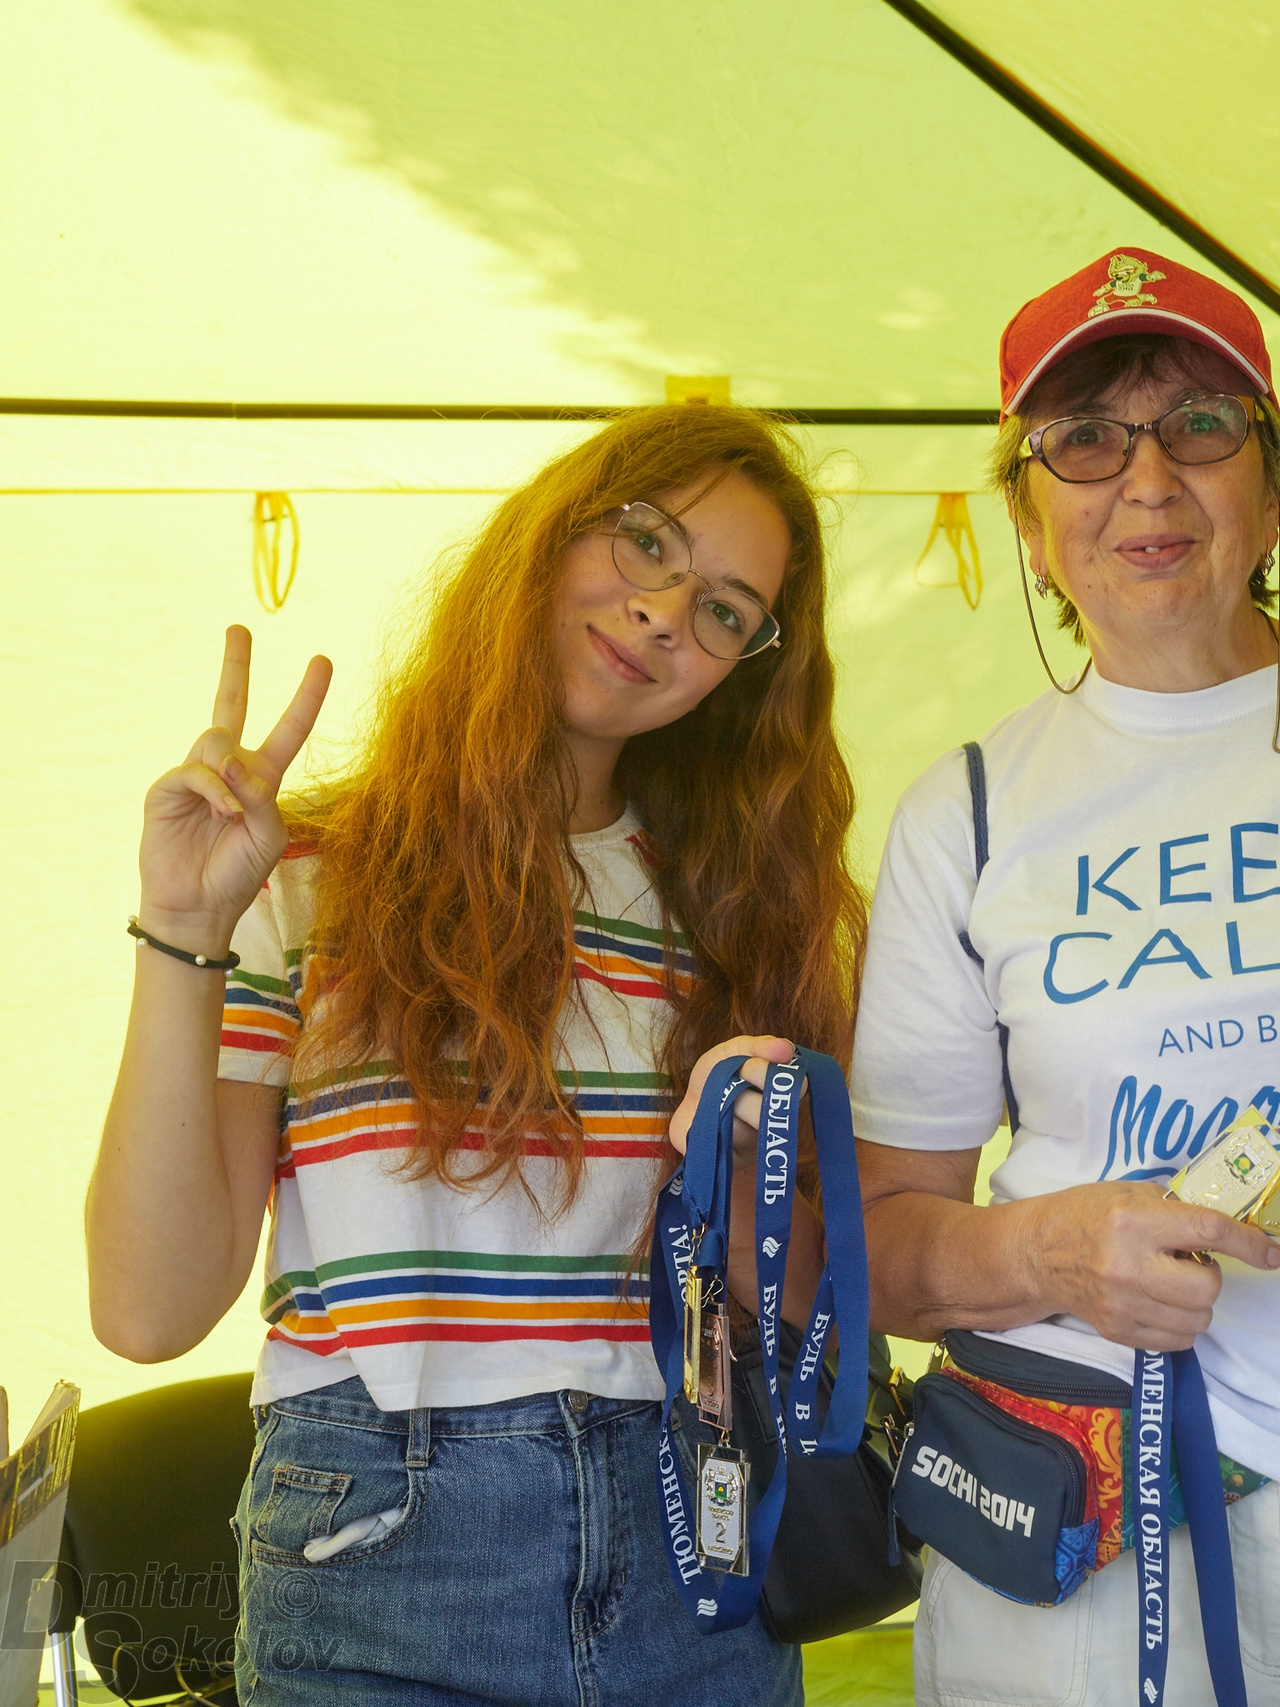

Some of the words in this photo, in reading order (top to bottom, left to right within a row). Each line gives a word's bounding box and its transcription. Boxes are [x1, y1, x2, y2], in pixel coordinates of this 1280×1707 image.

[1158, 1019, 1244, 1057] AND
[764, 1072, 796, 1205] ОБЛАСТЬ
[762, 1283, 778, 1356] БУДЬ
[799, 1311, 831, 1382] БУДЬ
[795, 1401, 811, 1421] В
[911, 1445, 978, 1508] SOCHI
[979, 1484, 1036, 1538] 2014
[1140, 1513, 1163, 1650] ОБЛАСТЬ
